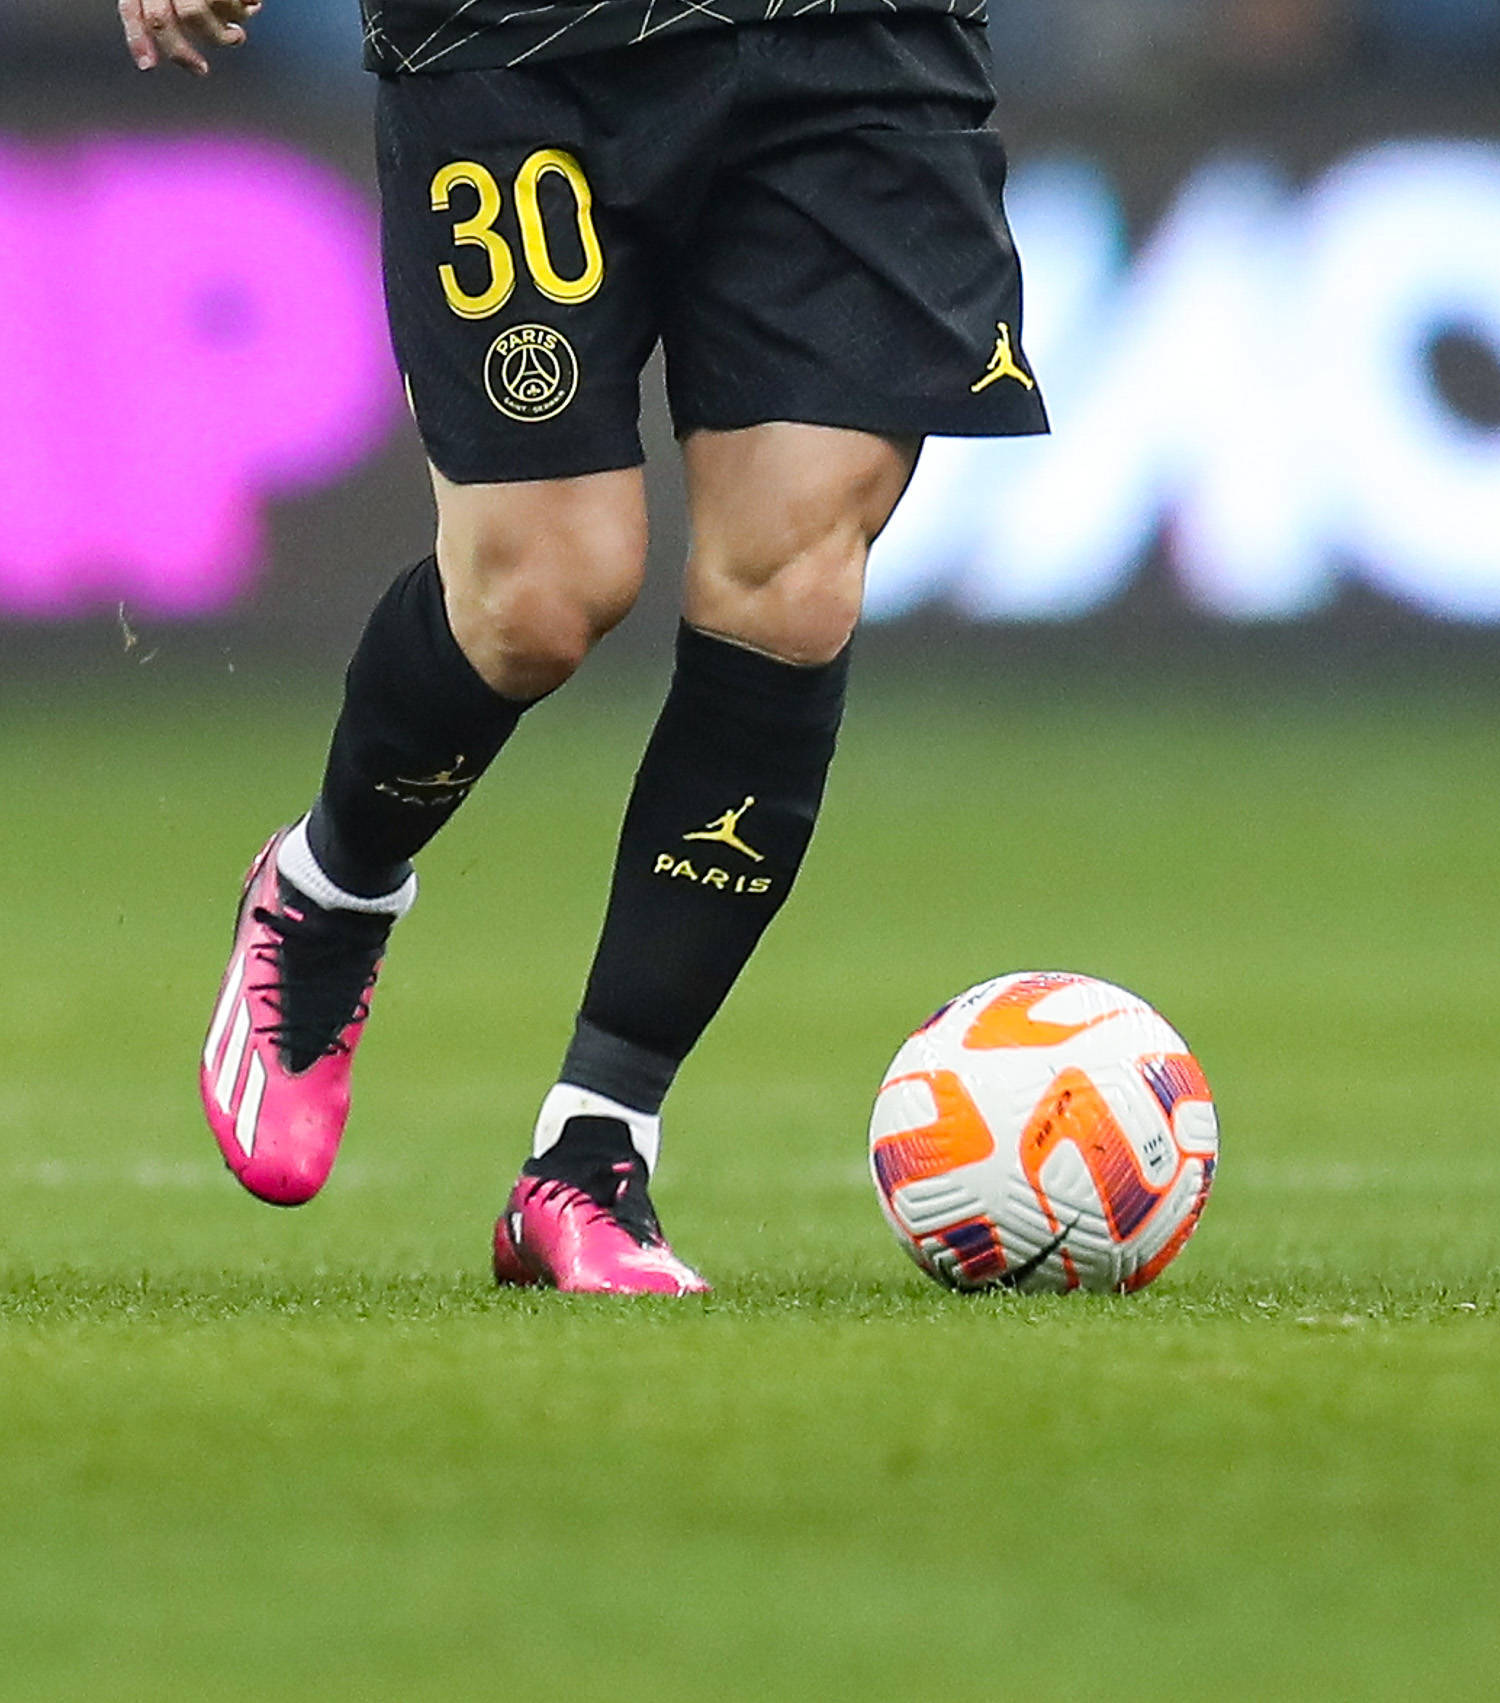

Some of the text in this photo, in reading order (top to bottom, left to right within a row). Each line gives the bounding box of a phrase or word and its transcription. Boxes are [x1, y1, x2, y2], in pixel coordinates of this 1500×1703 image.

[431, 149, 604, 320] 30
[496, 329, 558, 356] PARIS
[653, 852, 773, 893] PARIS
